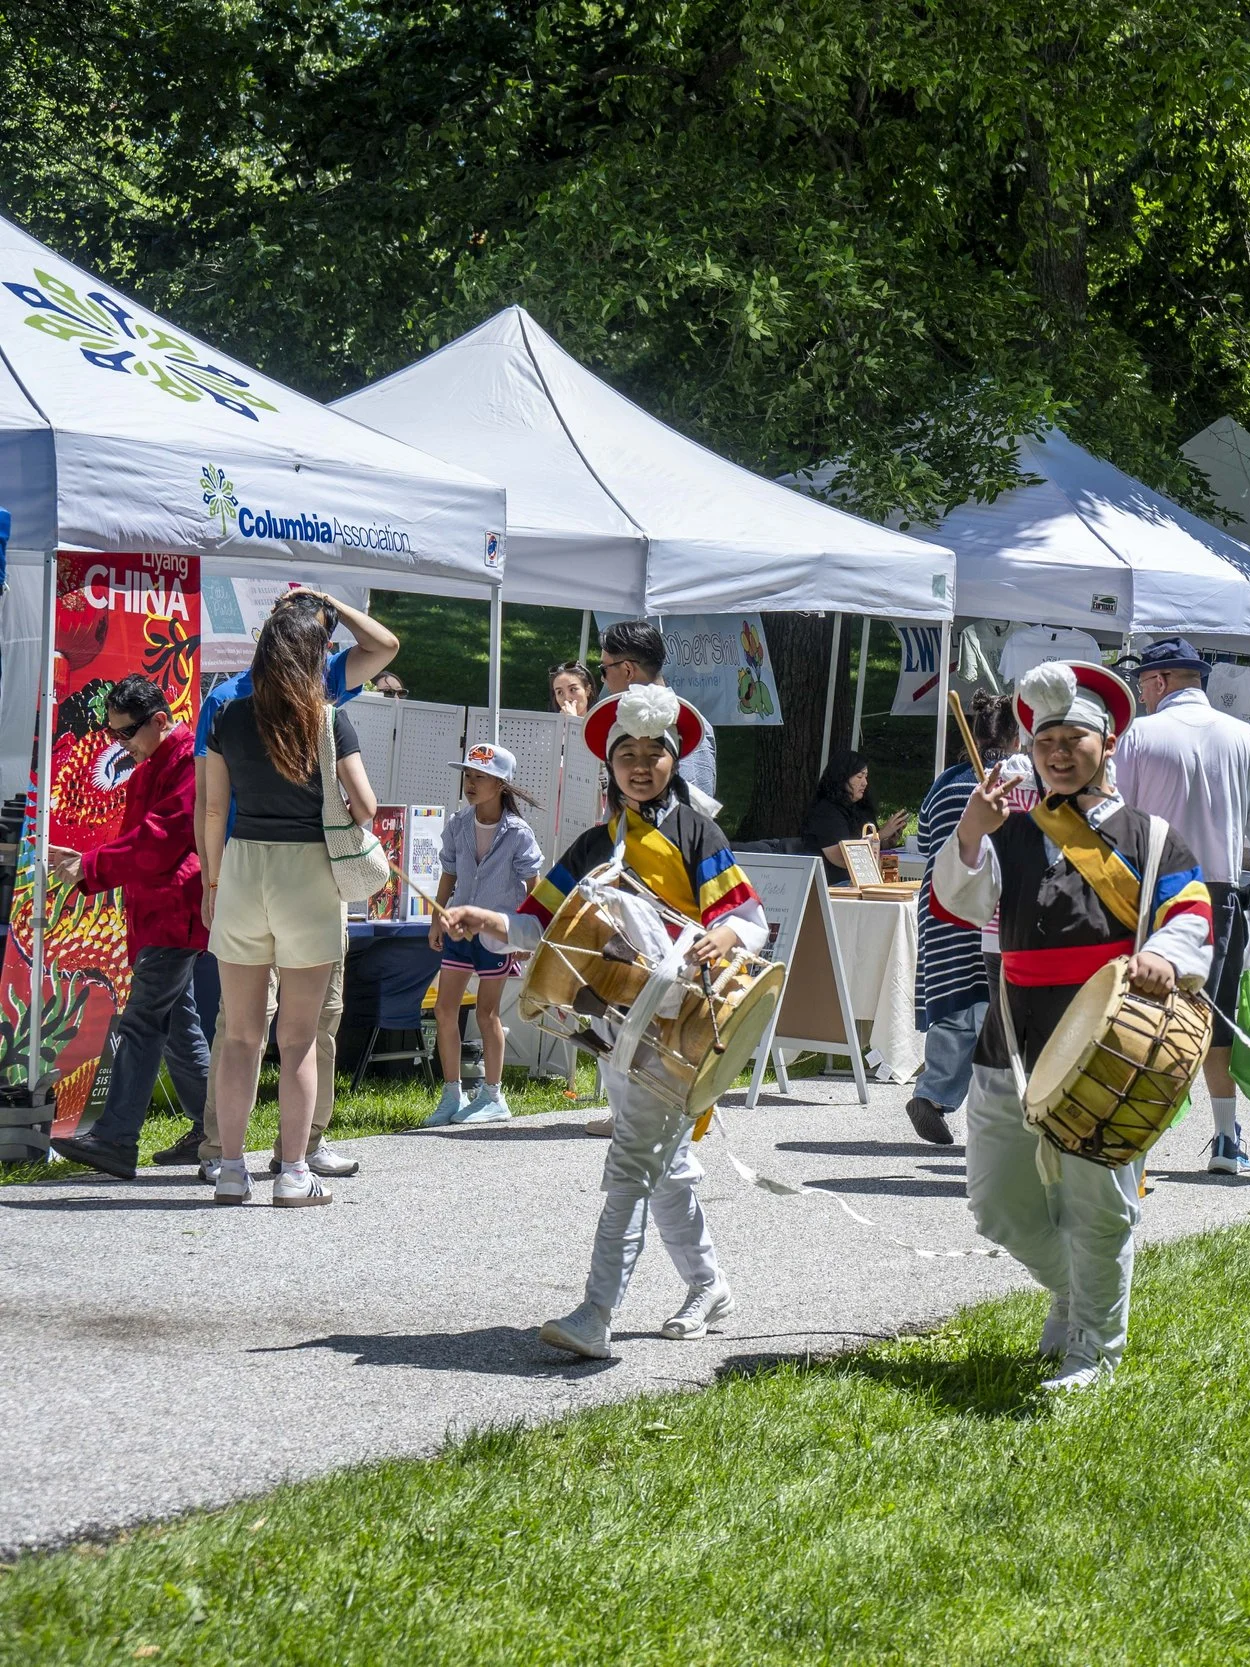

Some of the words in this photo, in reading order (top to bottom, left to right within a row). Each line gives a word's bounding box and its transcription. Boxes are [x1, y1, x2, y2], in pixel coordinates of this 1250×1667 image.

[142, 553, 189, 580] Liyang
[84, 564, 190, 621] CHINA
[671, 675, 685, 687] for
